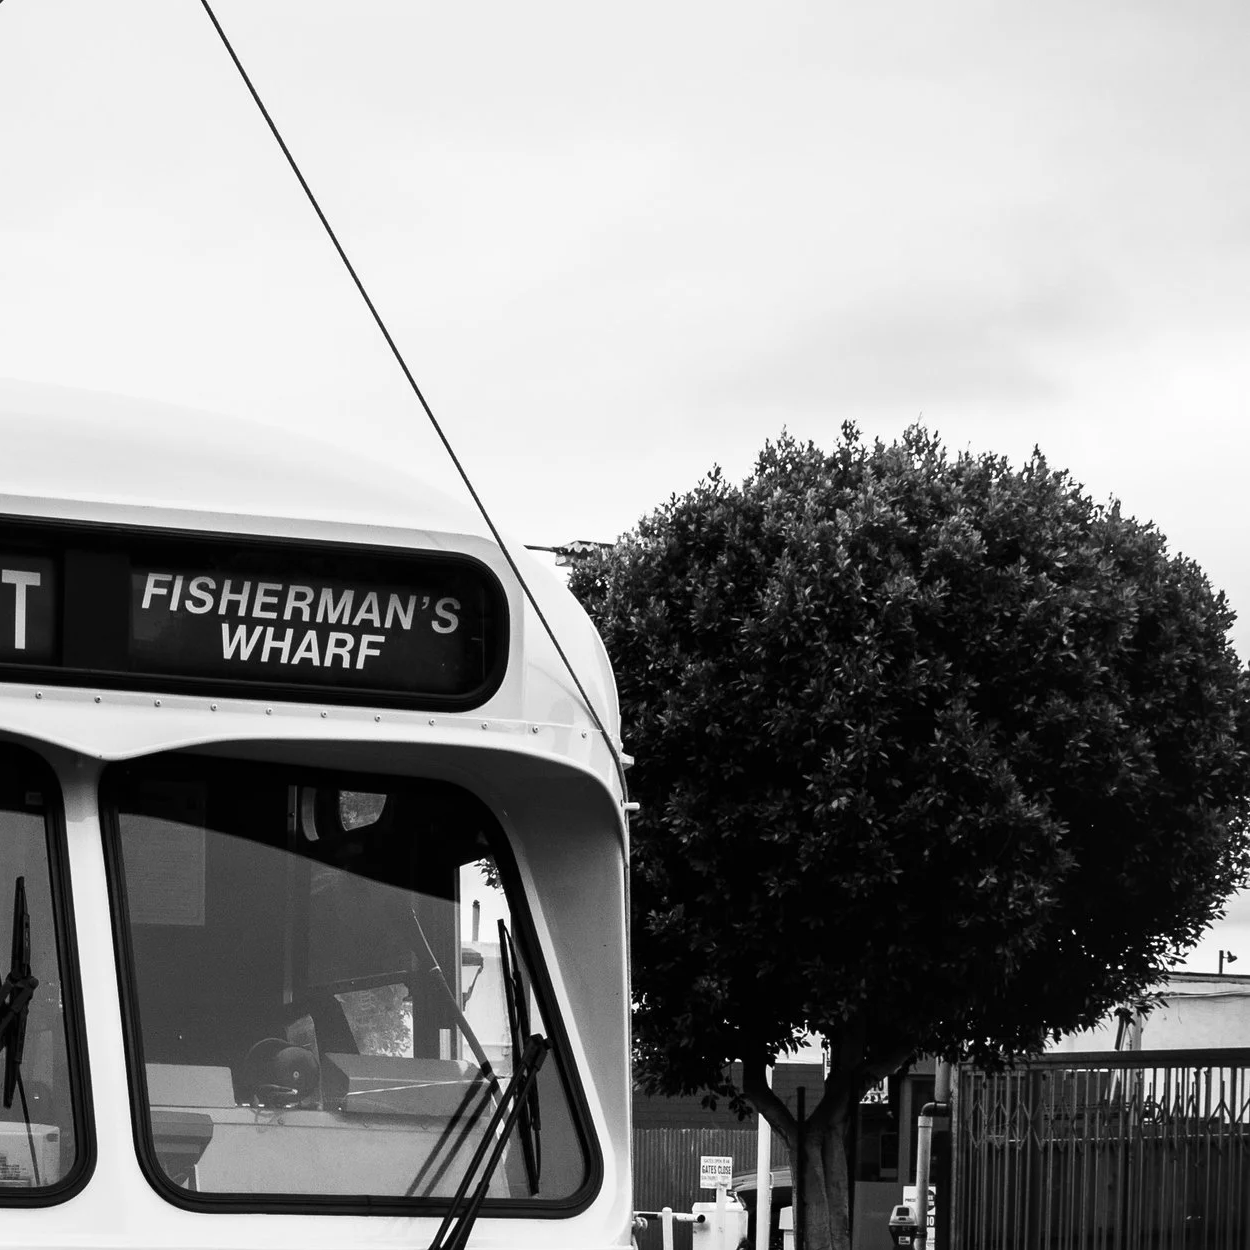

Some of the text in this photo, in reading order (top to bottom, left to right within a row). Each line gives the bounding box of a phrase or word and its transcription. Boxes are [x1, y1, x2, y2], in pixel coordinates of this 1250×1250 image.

[141, 572, 461, 634] FISHERMAN'S
[221, 622, 386, 670] WHARF
[702, 1165, 731, 1175] GATES CLOSE
